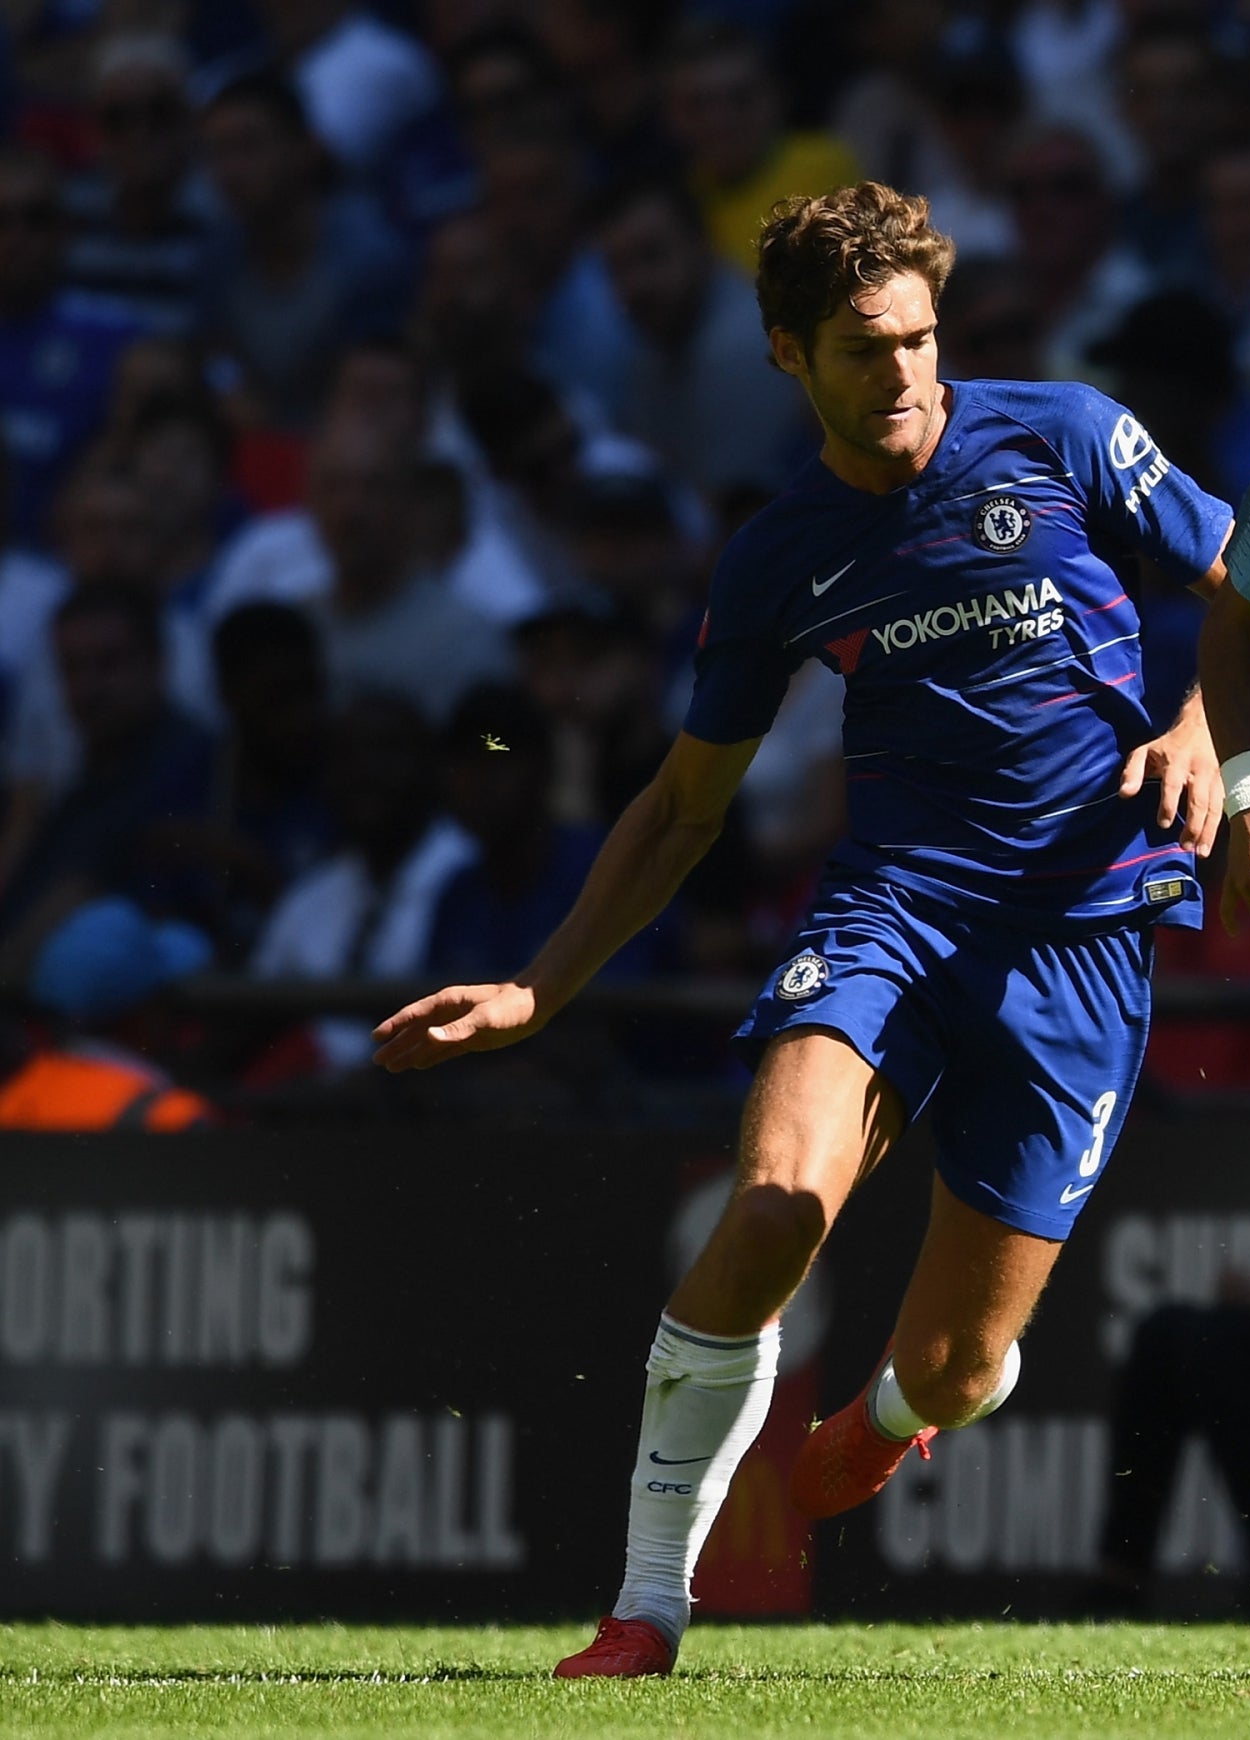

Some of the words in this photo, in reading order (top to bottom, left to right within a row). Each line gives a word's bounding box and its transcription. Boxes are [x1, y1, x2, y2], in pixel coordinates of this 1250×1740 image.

[980, 498, 1015, 516] CHELSEA
[871, 577, 1064, 655] YOKOHAMA
[988, 607, 1066, 650] TYRES
[1079, 1090, 1117, 1177] 3
[100, 1412, 527, 1568] FOOTBALL
[647, 1481, 692, 1494] CFC
